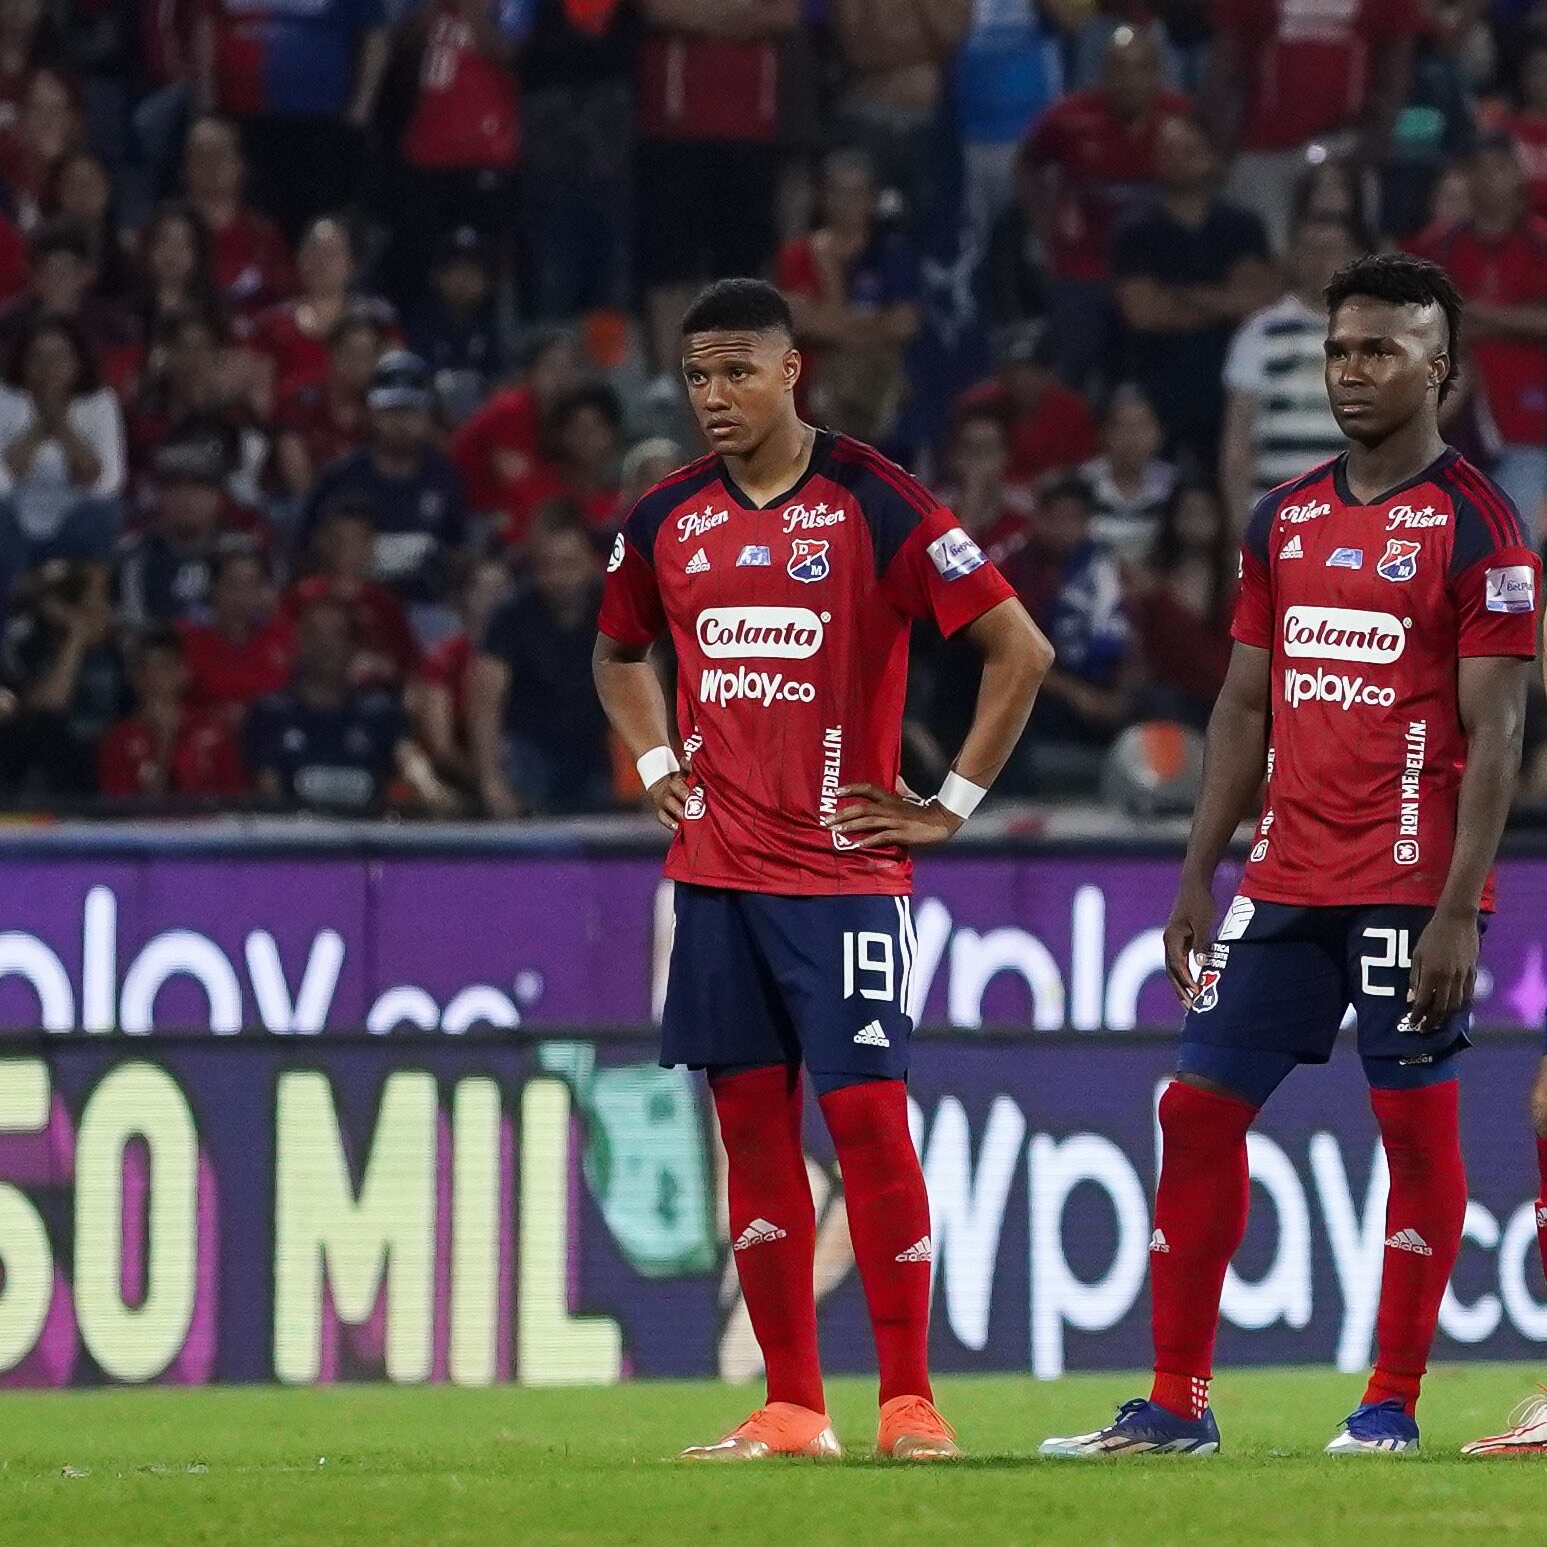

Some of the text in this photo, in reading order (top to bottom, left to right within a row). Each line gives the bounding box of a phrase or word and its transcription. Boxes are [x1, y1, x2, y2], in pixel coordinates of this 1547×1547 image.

[678, 509, 729, 542] Pilsen
[782, 504, 846, 534] Pilsen
[699, 617, 818, 648] Colanta
[1284, 615, 1400, 652] Colanta
[699, 665, 816, 707] Wplay.co
[1401, 719, 1427, 836] RON MEDELLÍN.
[842, 930, 895, 1001] 19
[272, 1069, 624, 1388] MIL
[735, 1229, 787, 1252] adidas
